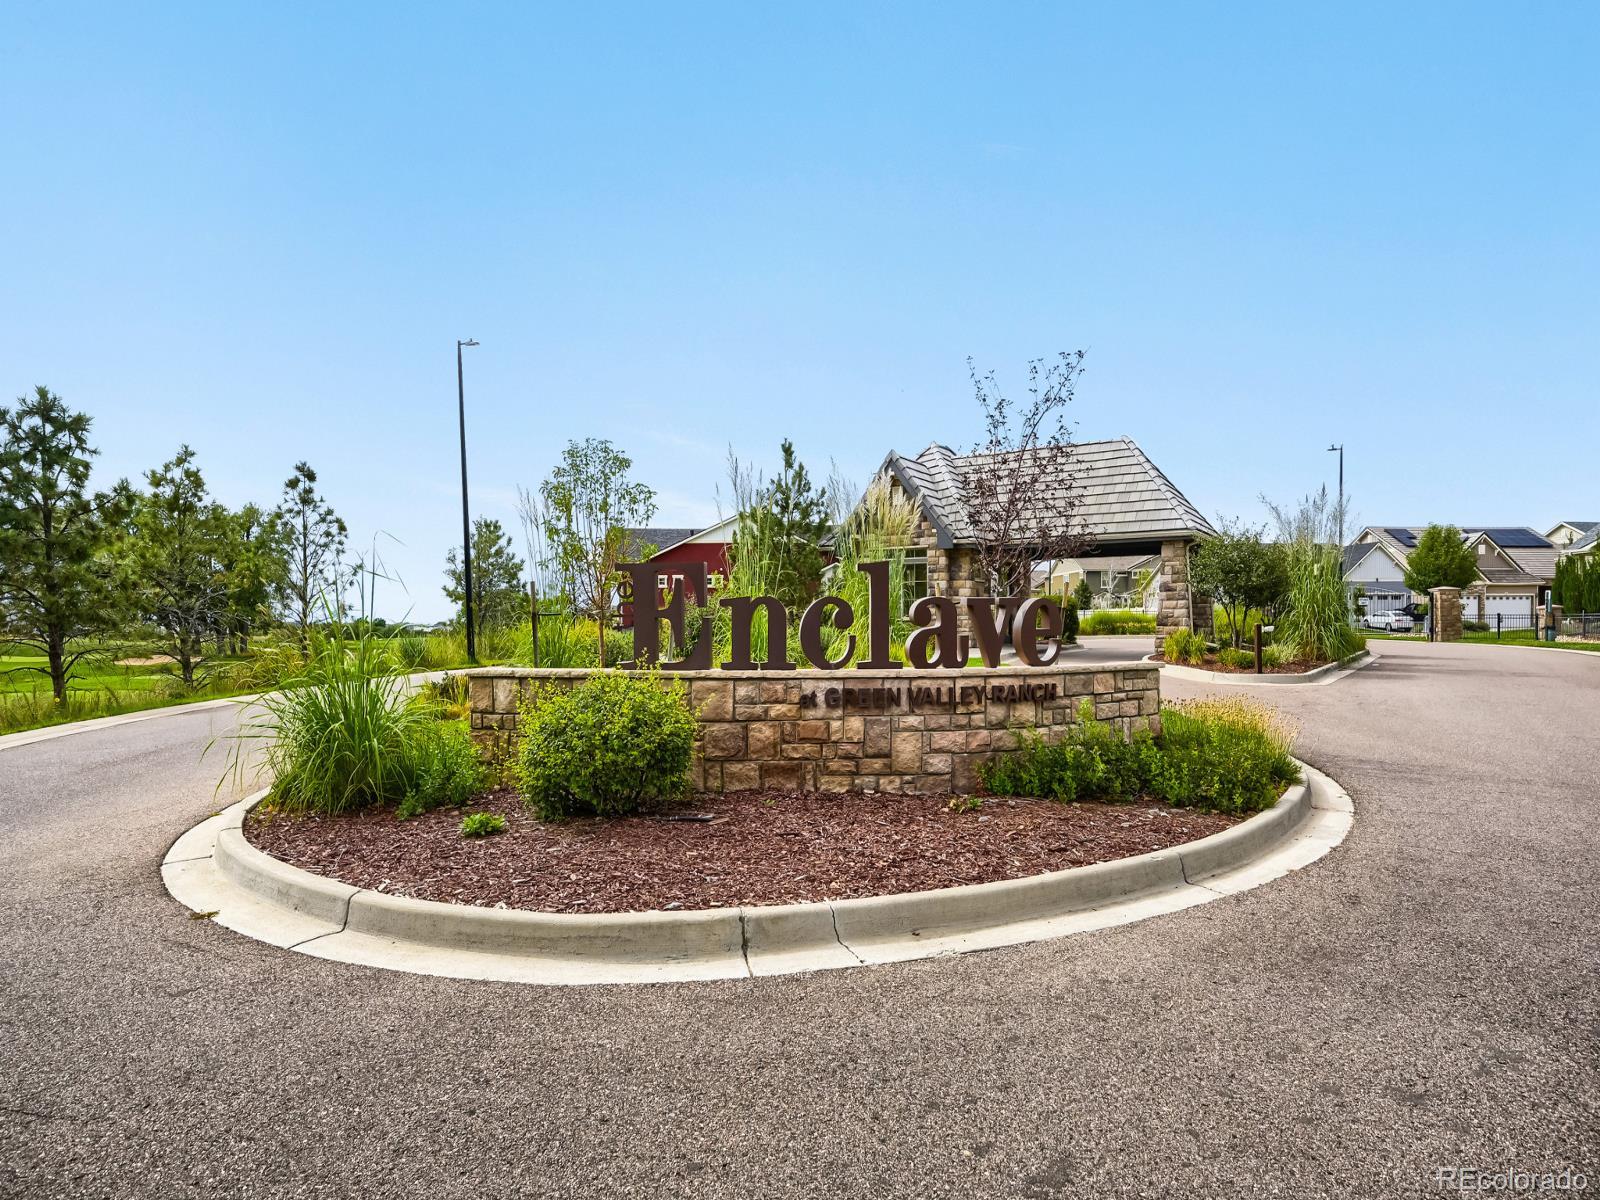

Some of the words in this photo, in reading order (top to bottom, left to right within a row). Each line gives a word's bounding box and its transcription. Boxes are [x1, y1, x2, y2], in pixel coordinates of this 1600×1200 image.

[615, 561, 1062, 670] Enclave
[800, 691, 817, 708] at
[824, 687, 901, 708] GREEN
[908, 686, 985, 706] VALLEY
[991, 683, 1057, 704] RANCH
